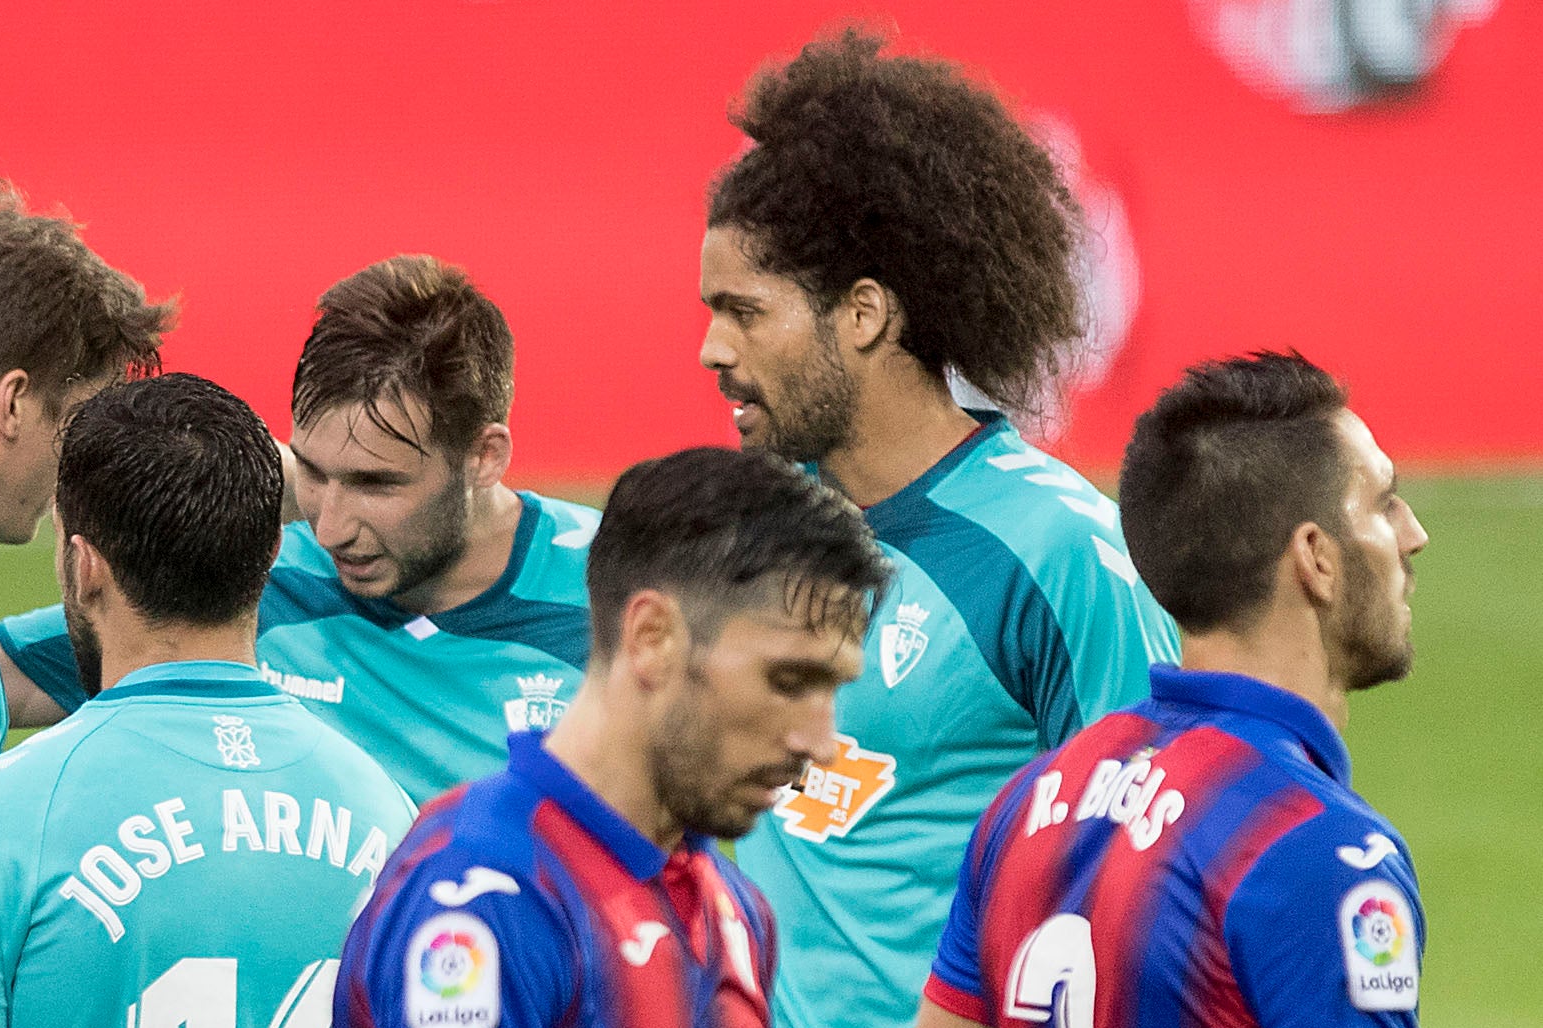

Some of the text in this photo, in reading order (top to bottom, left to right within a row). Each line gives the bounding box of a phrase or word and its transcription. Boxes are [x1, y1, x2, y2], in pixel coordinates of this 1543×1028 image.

[261, 661, 344, 704] hummel
[60, 798, 205, 943] JOSE
[1360, 971, 1414, 993] LaLiga
